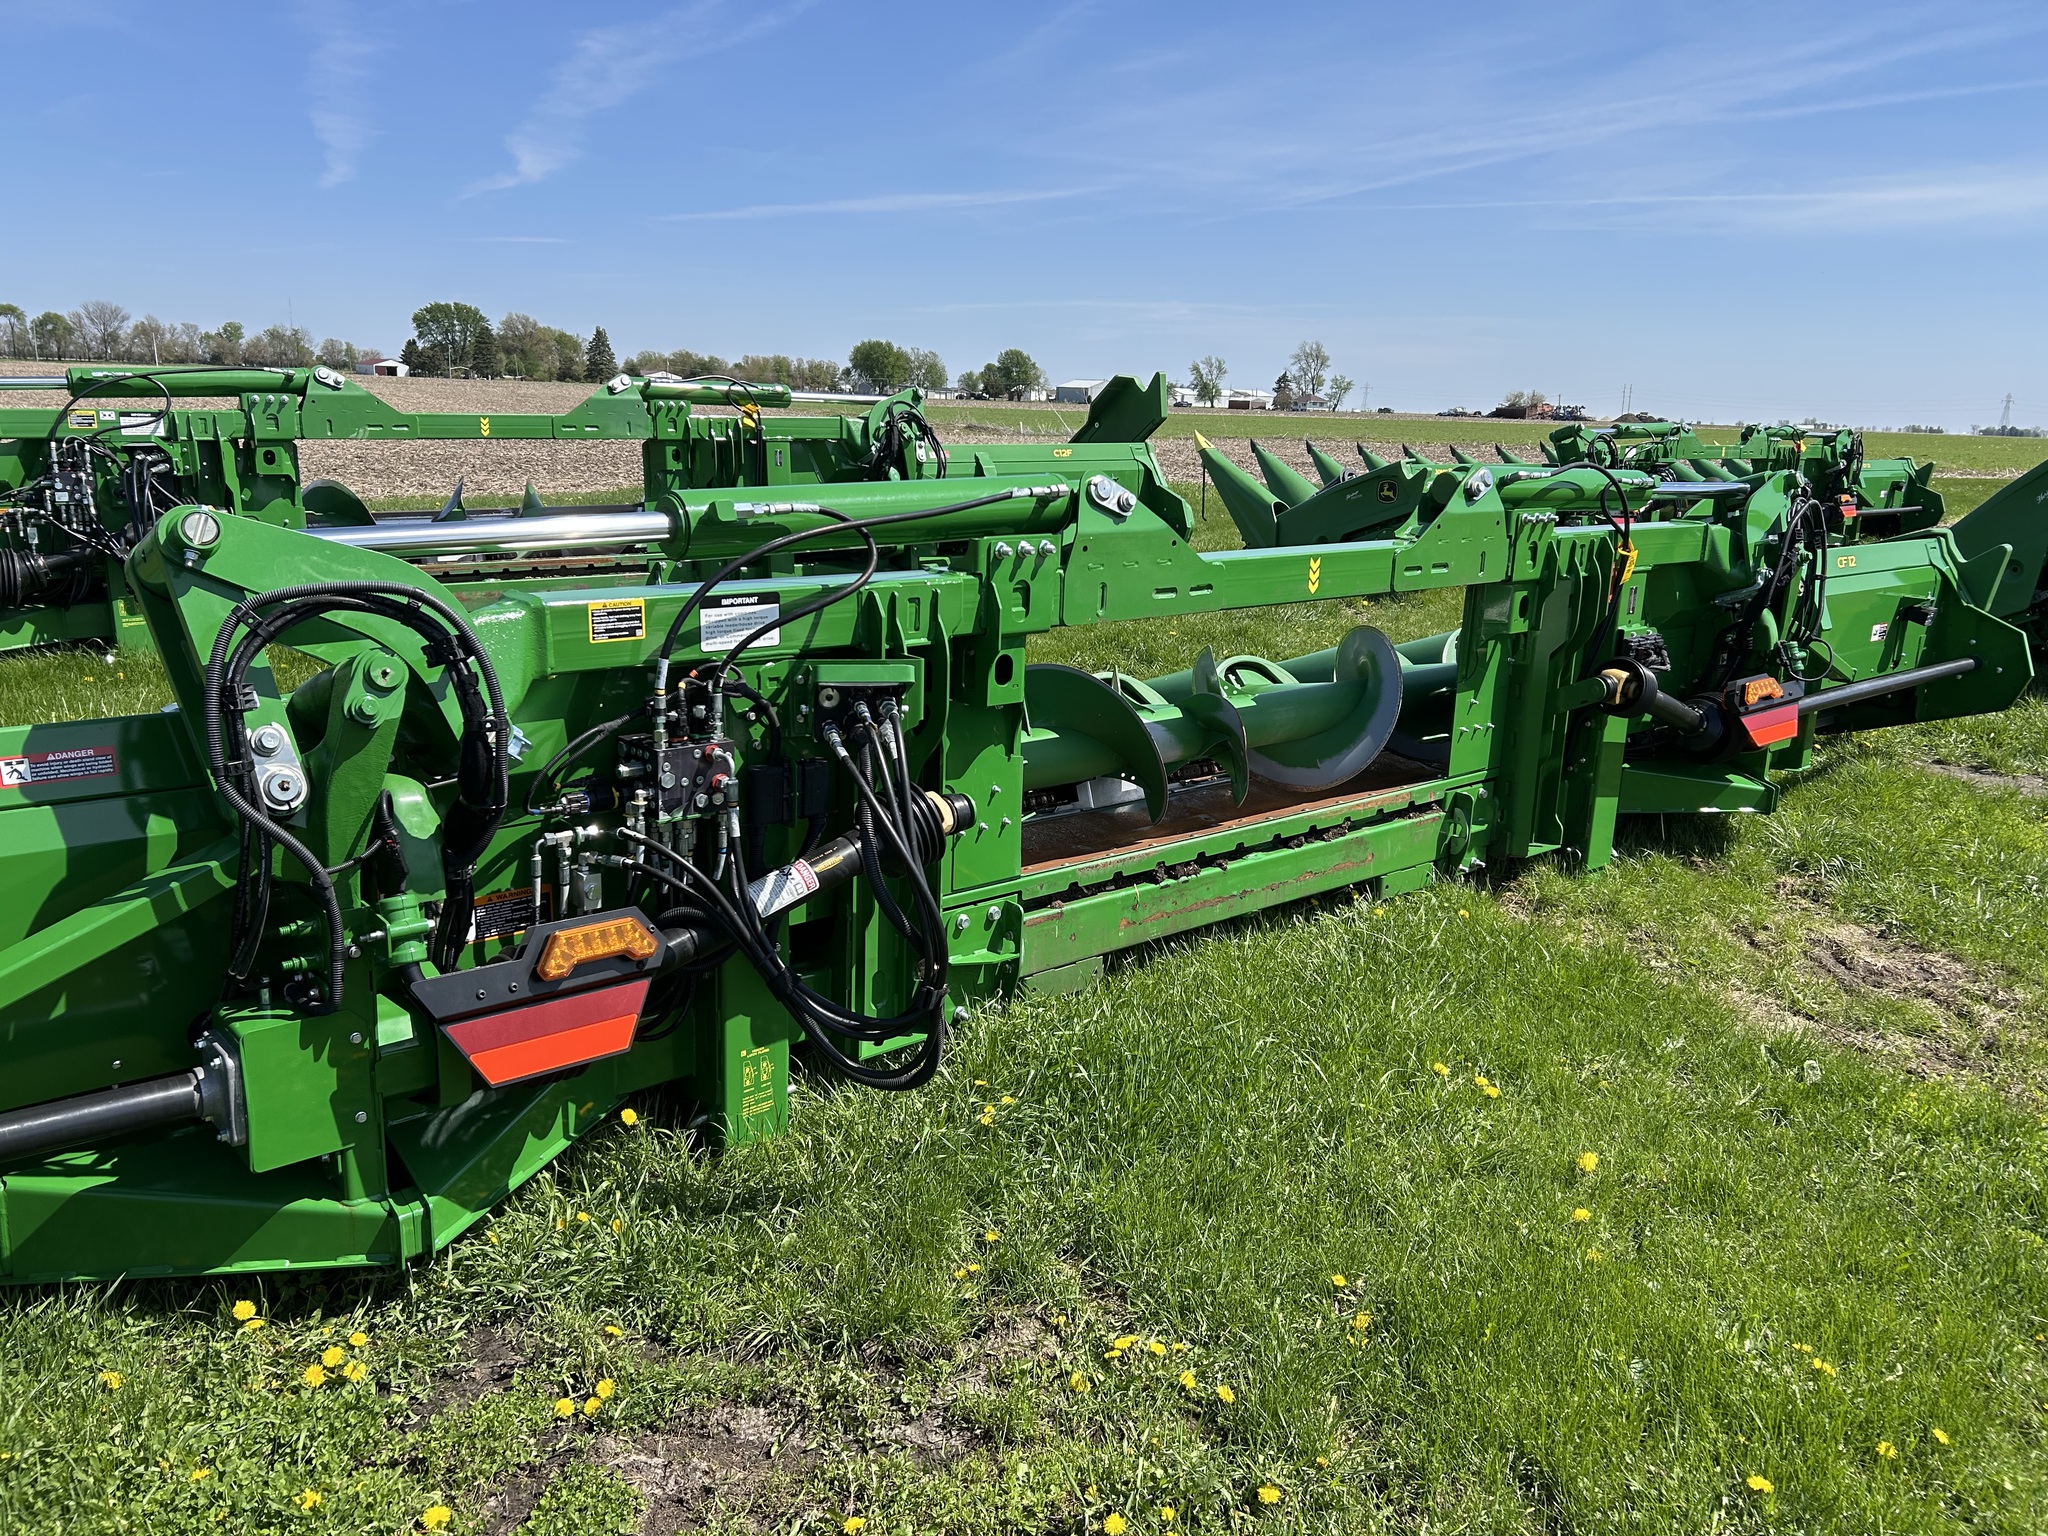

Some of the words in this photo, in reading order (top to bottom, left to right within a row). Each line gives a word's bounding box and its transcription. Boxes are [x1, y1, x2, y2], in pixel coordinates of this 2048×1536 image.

[1837, 555, 1857, 568] CF12
[721, 596, 759, 605] IMPORTANT
[55, 749, 95, 760] DANGER
[797, 862, 816, 891] DANGER
[496, 888, 532, 900] WARNING
